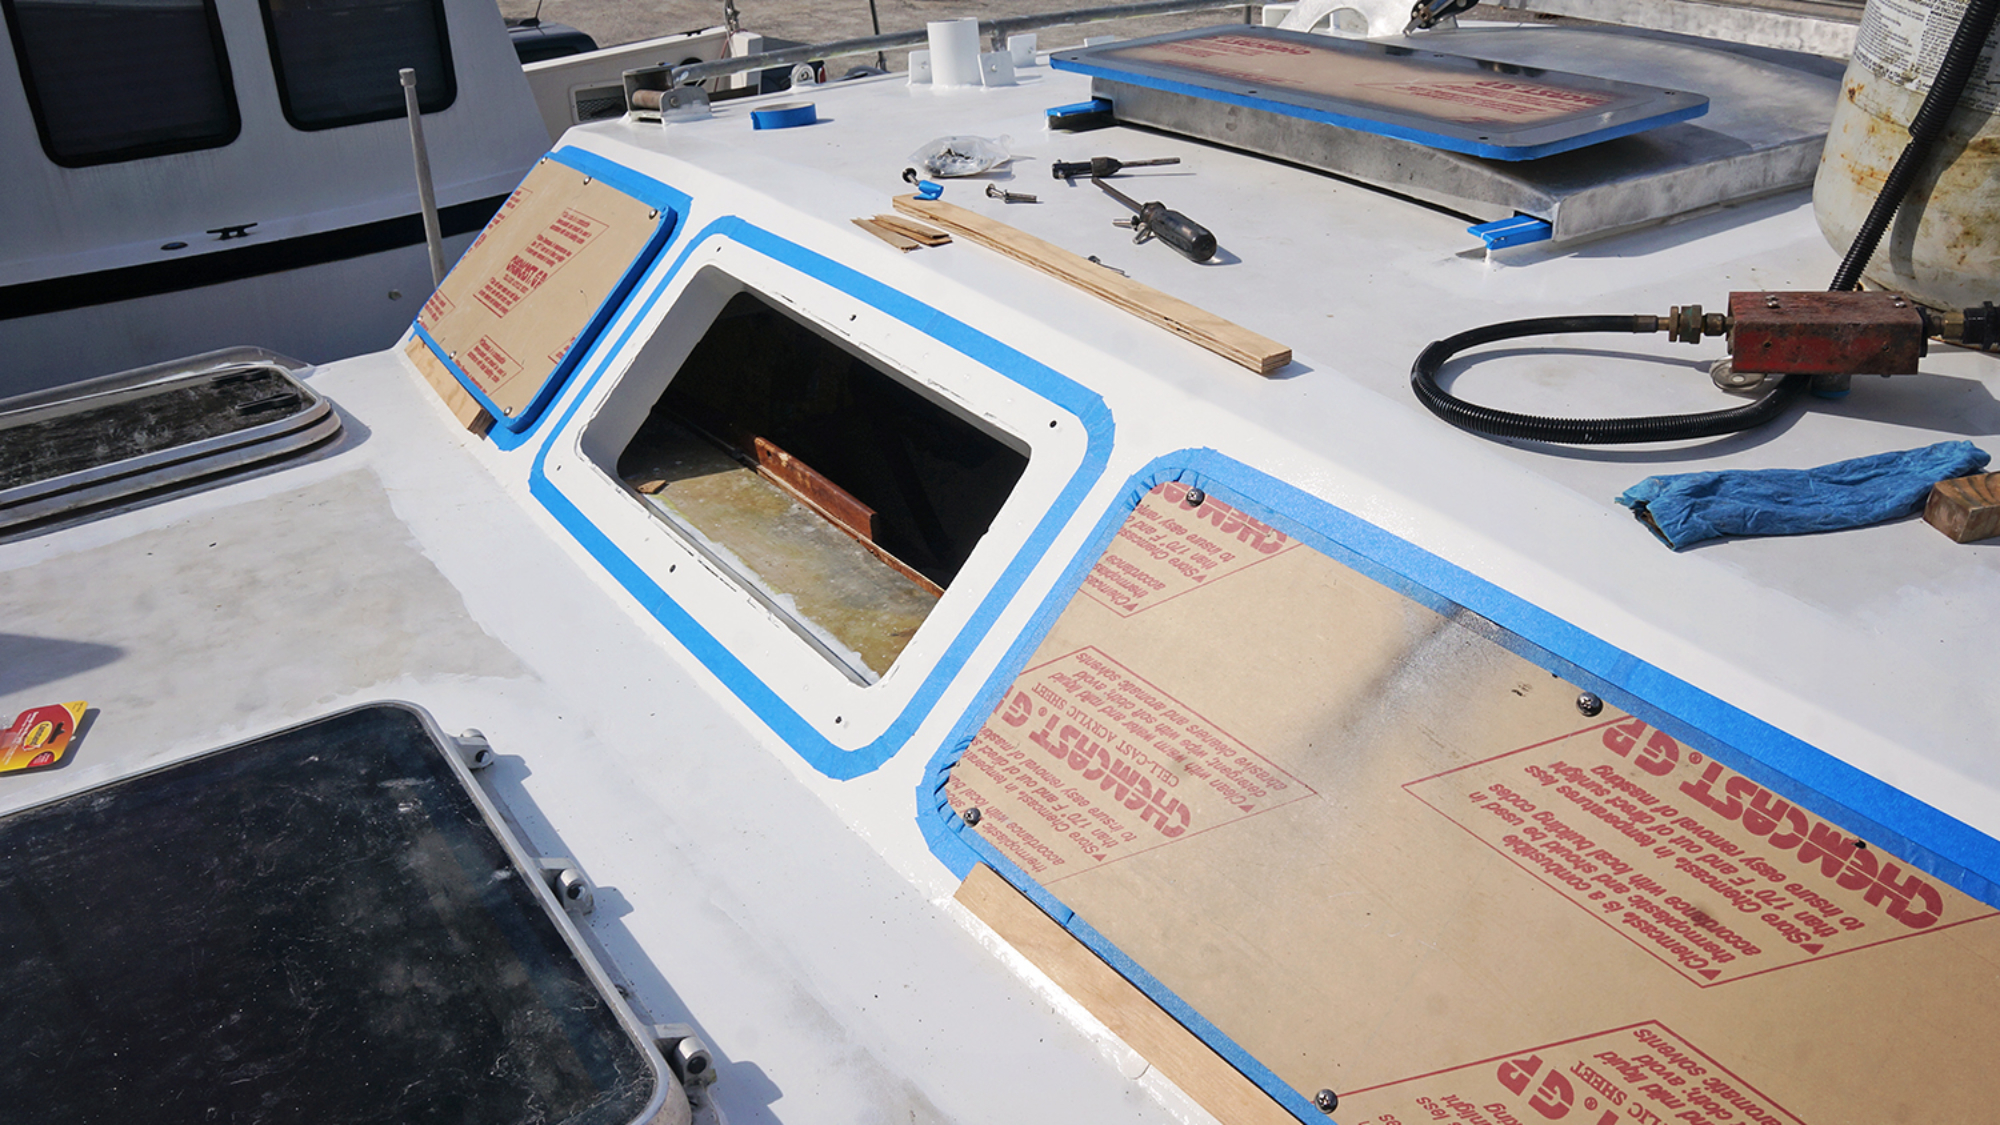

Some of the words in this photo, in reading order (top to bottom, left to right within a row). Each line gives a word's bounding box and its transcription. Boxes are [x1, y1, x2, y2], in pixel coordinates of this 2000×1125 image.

[1129, 520, 1157, 535] and
[1149, 534, 1168, 542] F
[1158, 518, 1188, 536] easy
[1186, 534, 1222, 555] insure
[1168, 557, 1200, 578] Store
[1189, 552, 1218, 570] than
[1219, 552, 1236, 563] to
[1105, 555, 1166, 591] accordance
[1075, 652, 1122, 682] solvents
[1048, 672, 1083, 694] liquid
[1072, 670, 1107, 691] avoid
[1031, 682, 1068, 710] SHEET
[1074, 690, 1109, 707] mild
[1117, 680, 1167, 711] aromatic
[1061, 705, 1117, 743] ACRYLIC
[1097, 705, 1134, 722] and
[1131, 708, 1158, 724] soft
[1159, 709, 1190, 726] and
[1121, 716, 1156, 742] water
[1154, 723, 1180, 740] with
[1153, 740, 1187, 763] warm
[1179, 739, 1208, 759] wipe
[1185, 724, 1237, 758] cleaners
[1601, 719, 1680, 776] GP
[977, 745, 1009, 767] direct
[1006, 750, 1026, 760] of
[1115, 740, 1180, 788] CELL-CAST
[1002, 765, 1021, 775] of
[1015, 773, 1038, 788] out
[1019, 758, 1065, 789] removal
[1183, 762, 1212, 780] with
[1234, 757, 1287, 790] abrasive
[1524, 765, 1560, 787] less
[1548, 761, 1611, 797] sunlight
[1004, 778, 1019, 794] in
[1031, 787, 1059, 803] and
[1209, 779, 1247, 805] Clean
[1590, 764, 1660, 806] masking
[959, 788, 989, 808] local
[1051, 804, 1069, 812] F
[1060, 787, 1090, 807] easy
[1469, 791, 1488, 803] in
[1488, 783, 1537, 813] codes
[984, 805, 1008, 823] with
[1087, 807, 1124, 831] insure
[1480, 801, 1525, 826] used
[1556, 785, 1657, 847] temperatures
[1604, 796, 1656, 825] direct
[1649, 804, 1679, 818] of
[1091, 828, 1119, 848] than
[1120, 831, 1137, 842] to
[1522, 826, 1550, 842] be
[1531, 811, 1596, 851] building
[1645, 823, 1675, 837] of
[1670, 816, 1745, 857] removal
[982, 822, 1047, 873] thermoplastic
[1006, 822, 1065, 866] accordance
[1068, 831, 1100, 854] Store
[1652, 845, 1676, 859] in
[1667, 835, 1704, 854] out
[1502, 834, 1592, 891] combustible
[1539, 836, 1598, 874] should
[1585, 849, 1634, 876] local
[1694, 853, 1739, 875] and
[1738, 856, 1787, 883] easy
[1590, 873, 1639, 895] and
[1628, 873, 1667, 897] with
[1727, 876, 1756, 887] F
[1587, 890, 1607, 901] a
[1602, 900, 1625, 914] is
[1784, 883, 1844, 918] insure
[1627, 894, 1736, 964] thermoplastic
[1664, 896, 1762, 956] accordance
[1760, 913, 1812, 944] Store
[1793, 911, 1840, 938] than
[1838, 916, 1866, 931] to
[1633, 1028, 1707, 1077] solvents
[1593, 1051, 1649, 1084] liquid
[1630, 1054, 1686, 1087] avoid
[1496, 1053, 1575, 1121] GP
[1569, 1060, 1628, 1106] SHEET
[1637, 1083, 1686, 1110] mild
[1681, 1086, 1734, 1121] cloth;
[1415, 1096, 1451, 1121] less
